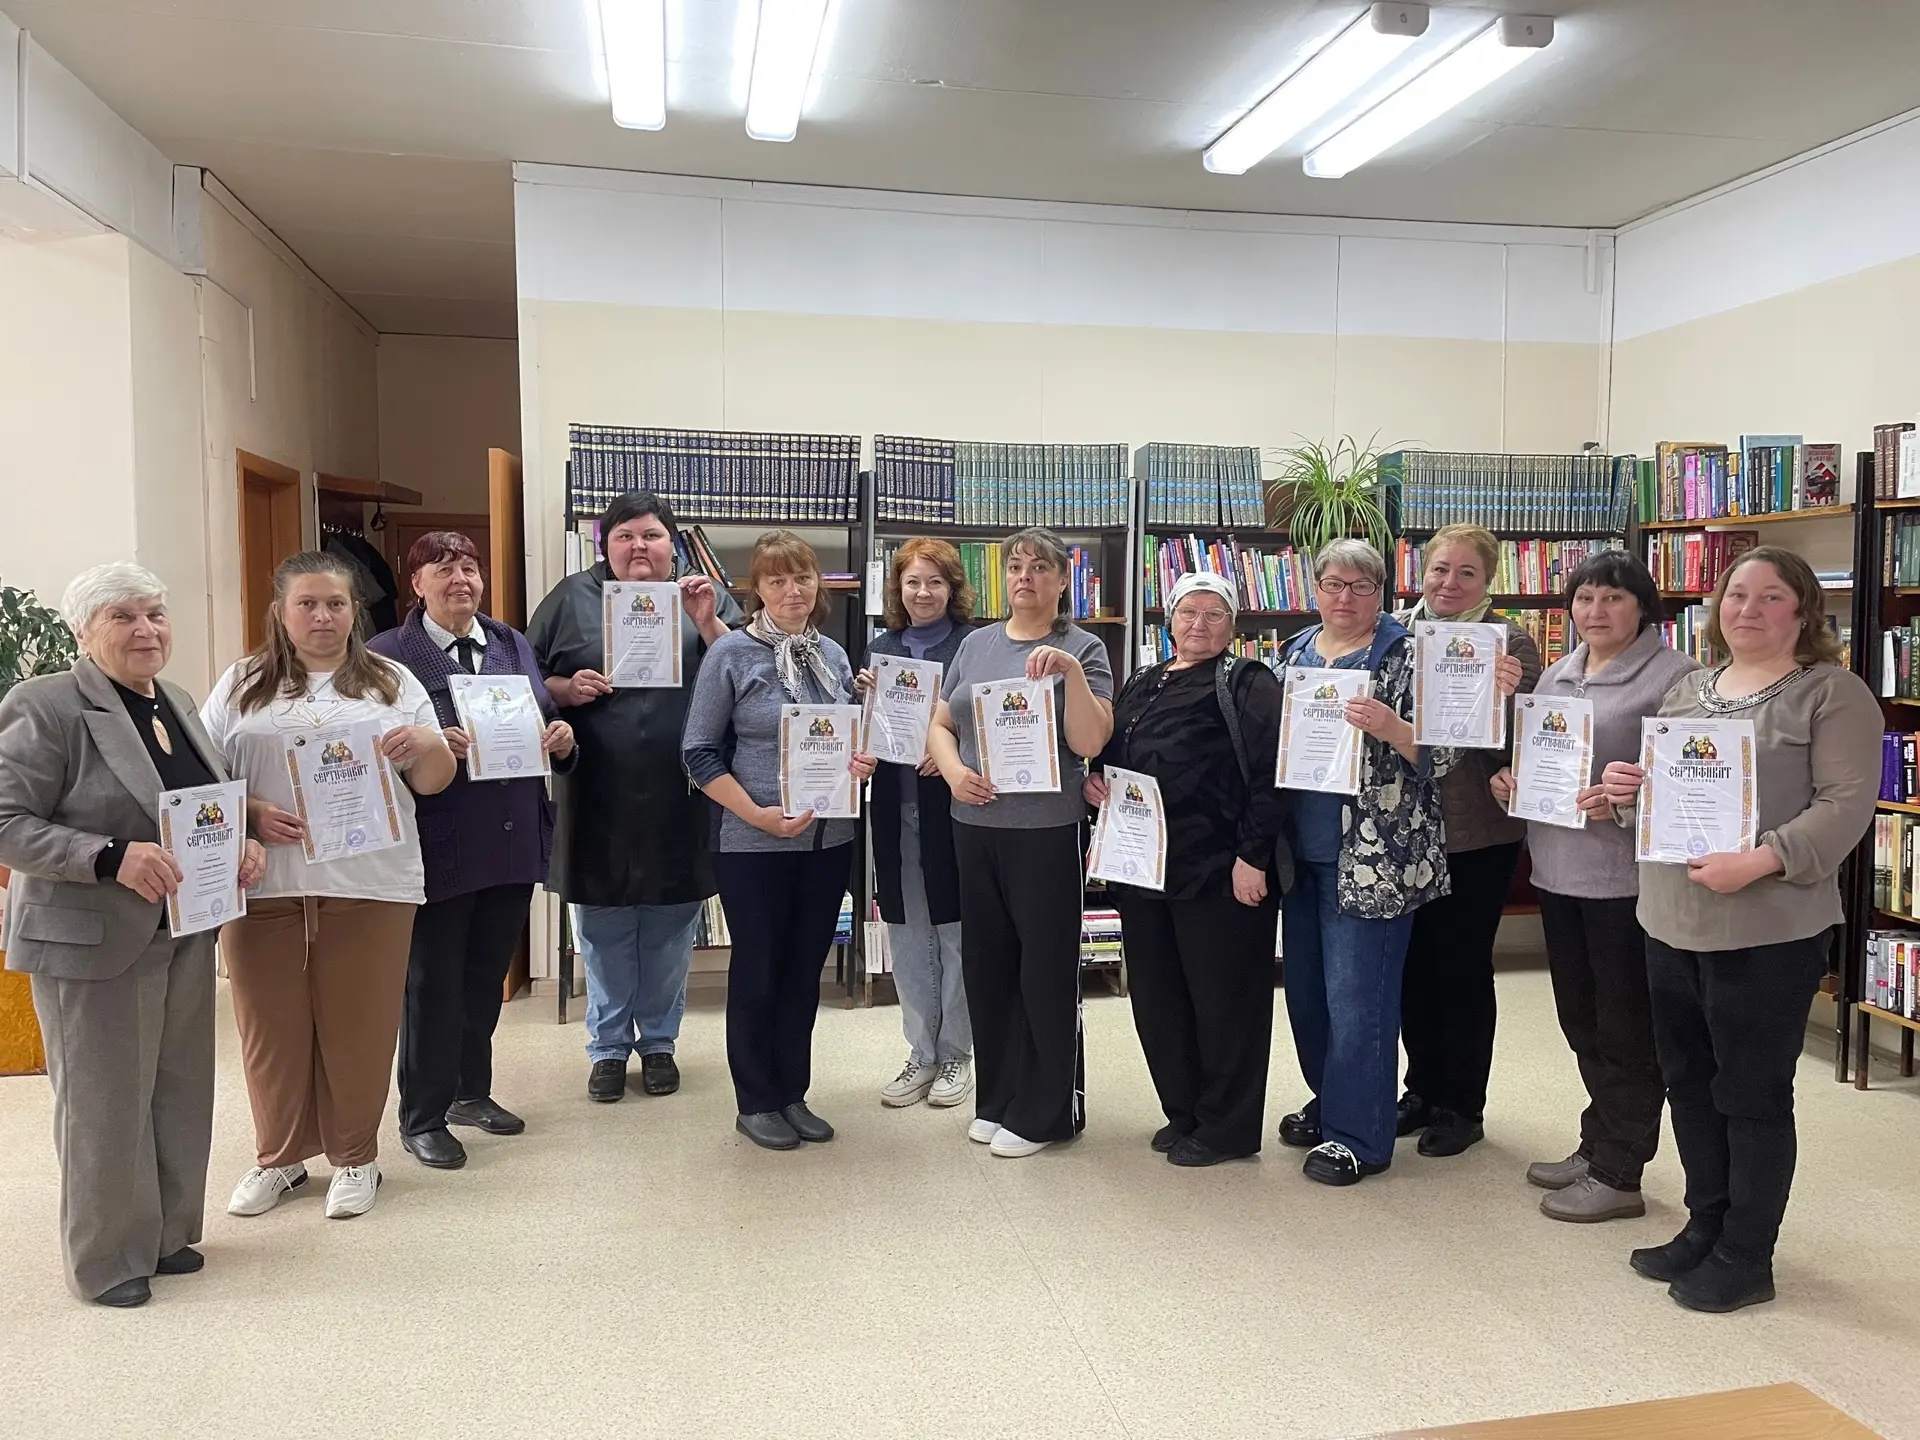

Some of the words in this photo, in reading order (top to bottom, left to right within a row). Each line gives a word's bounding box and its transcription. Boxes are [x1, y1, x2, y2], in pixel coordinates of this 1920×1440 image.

[1435, 664, 1486, 674] СЕРТИФИКАТ
[1303, 708, 1344, 719] СЕРТИФИКА
[314, 764, 368, 784] СЕРТИФИКАТ
[1669, 766, 1731, 778] СЕРТИФИКАТ
[187, 828, 233, 847] СЕРТИФИКАТ
